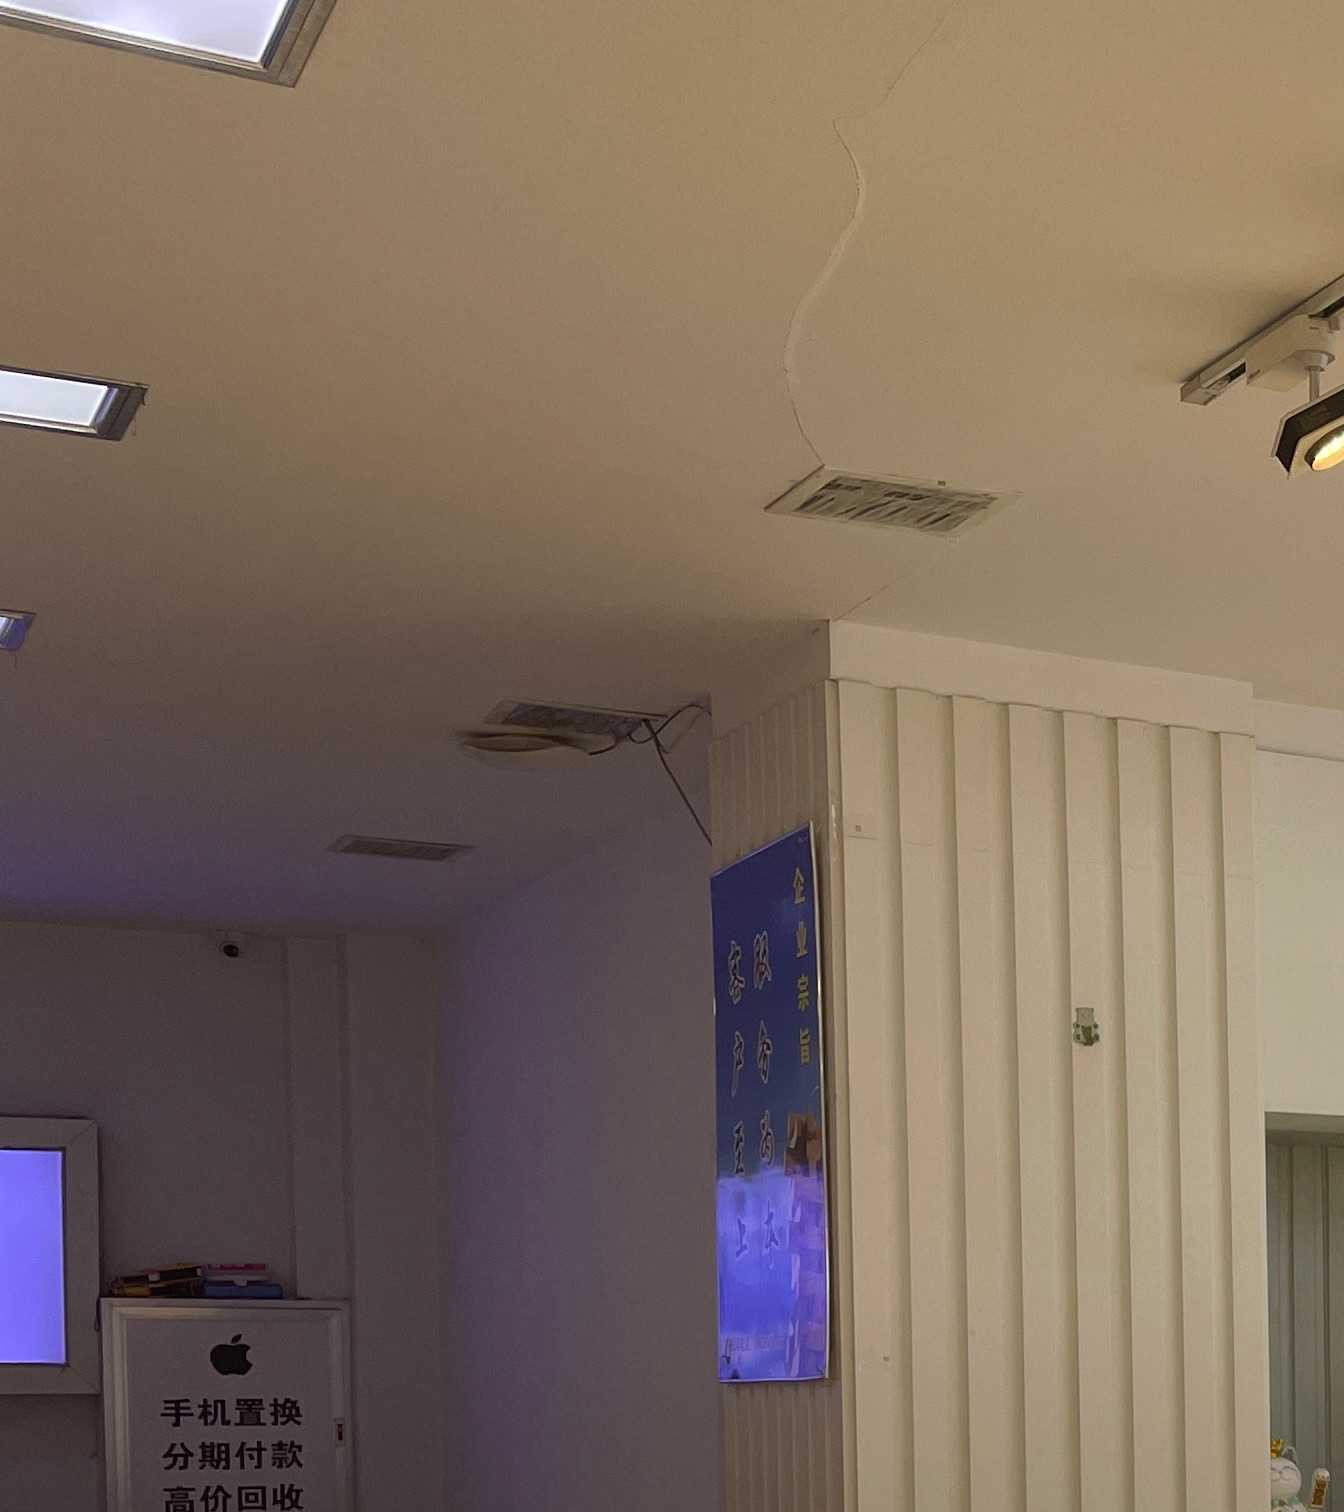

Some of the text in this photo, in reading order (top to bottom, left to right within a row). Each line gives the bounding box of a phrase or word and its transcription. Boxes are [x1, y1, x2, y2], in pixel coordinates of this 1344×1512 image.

[160, 1397, 303, 1428] 手机置换
[162, 1440, 304, 1471] 分期付款
